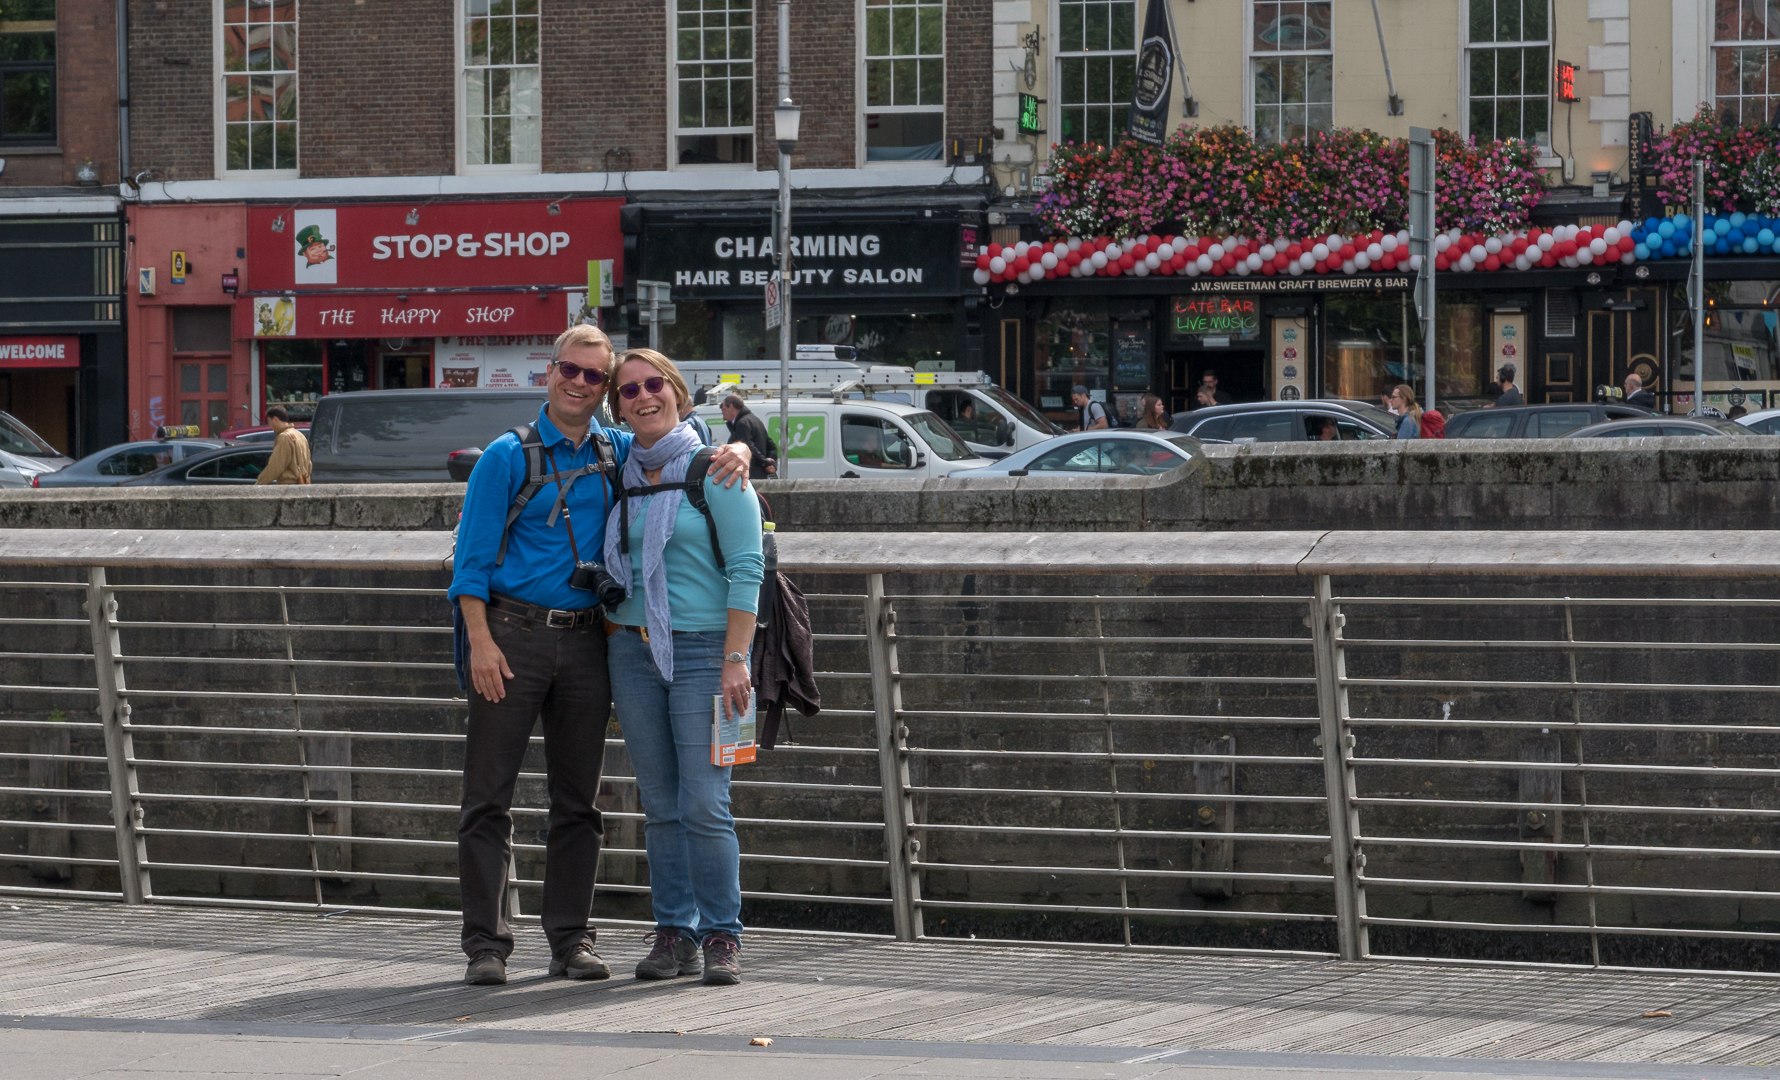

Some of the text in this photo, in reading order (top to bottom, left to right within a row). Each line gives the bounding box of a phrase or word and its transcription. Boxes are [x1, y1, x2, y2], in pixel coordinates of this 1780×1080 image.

[714, 234, 880, 258] CHARMING
[675, 270, 730, 286] HAIR
[843, 267, 923, 284] SALON
[1278, 279, 1316, 291] CRAFT
[1317, 278, 1372, 290] BREWERY
[1374, 278, 1383, 288] &
[1385, 277, 1409, 288] BAR
[1174, 298, 1255, 314] LATE BAR
[319, 306, 515, 325] THE HAPPY SHOP
[1176, 315, 1256, 330] LIVE MUSIC
[458, 335, 484, 346] THE
[487, 335, 533, 346] APPY
[0, 344, 65, 359] WELCOME
